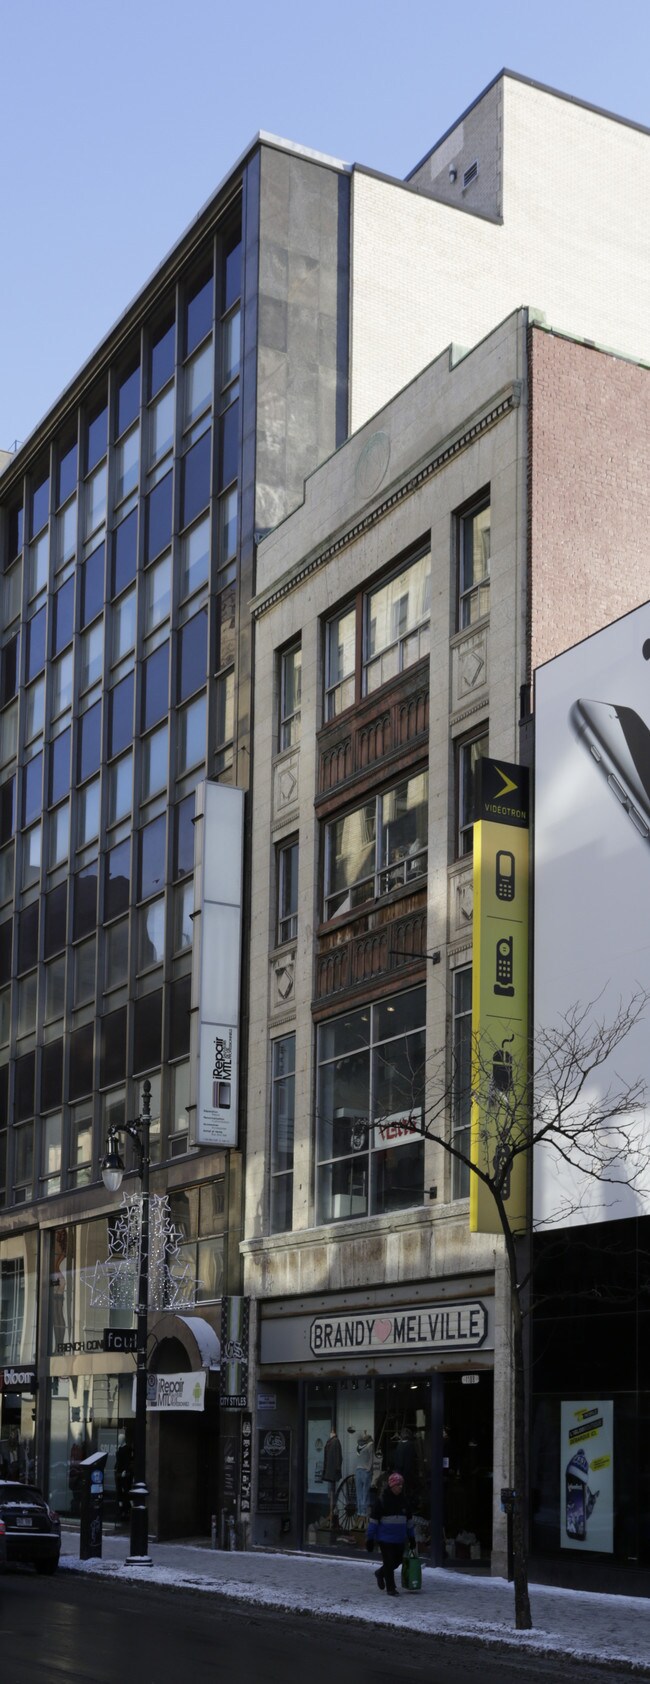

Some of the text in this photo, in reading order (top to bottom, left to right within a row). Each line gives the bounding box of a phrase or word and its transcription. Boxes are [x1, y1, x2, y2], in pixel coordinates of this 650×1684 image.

[484, 803, 526, 819] VIDEOTRON
[213, 1037, 225, 1080] iRepair
[222, 1059, 232, 1081] MTL
[314, 1310, 481, 1349] BRANDY MELVILLE
[57, 1341, 85, 1353] FRENCH
[3, 1369, 35, 1385] bloom
[158, 1377, 184, 1393] iRepair
[158, 1392, 171, 1407] MTL
[220, 1396, 229, 1406] CITY
[230, 1396, 247, 1406] STYLES
